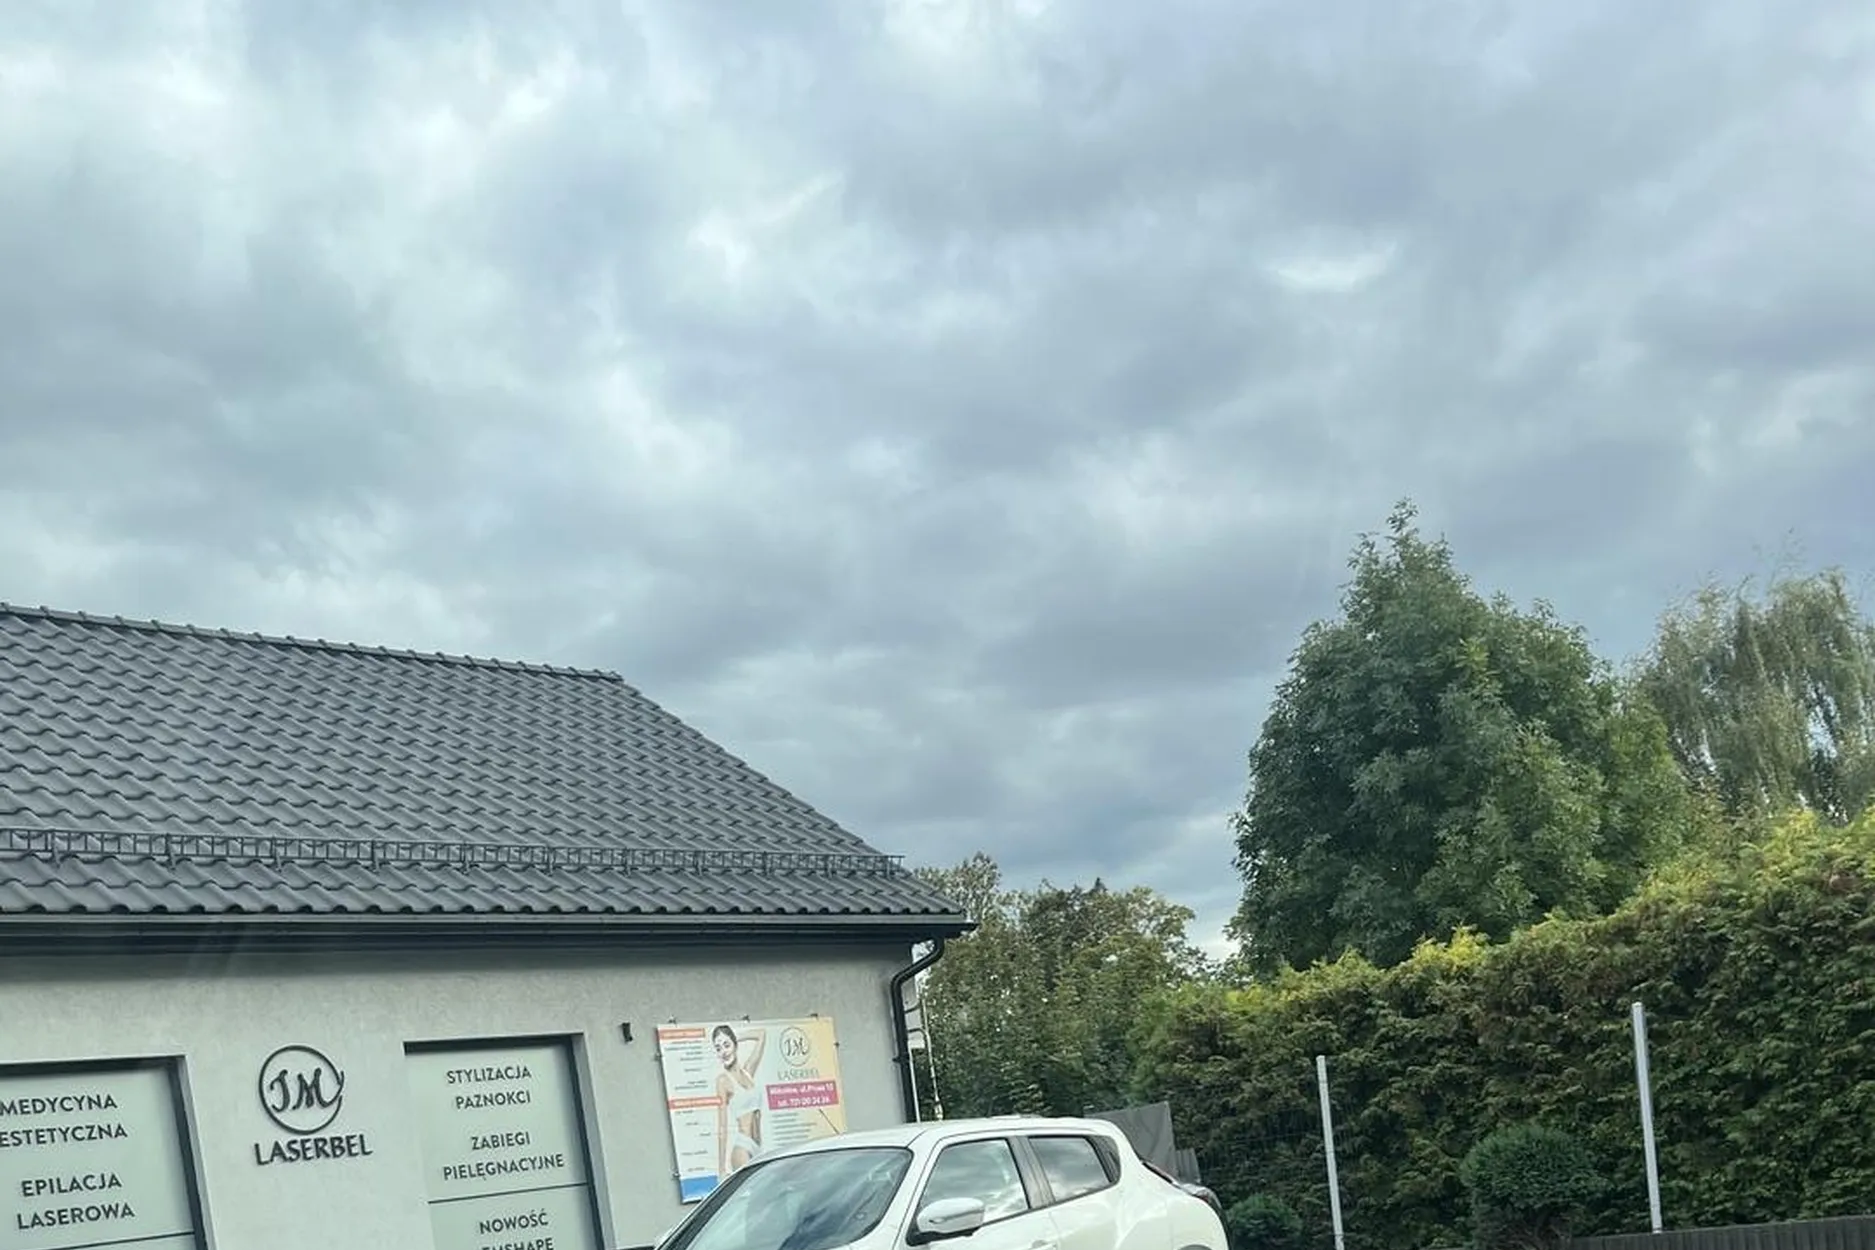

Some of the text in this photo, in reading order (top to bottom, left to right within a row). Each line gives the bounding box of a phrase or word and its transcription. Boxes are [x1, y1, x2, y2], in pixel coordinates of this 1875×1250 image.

[446, 1066, 532, 1085] STYLIZACJA
[0, 1094, 118, 1117] MEDYCYNA
[455, 1090, 531, 1110] PAZNOKCI
[0, 1123, 128, 1147] ESTETYCZNA
[471, 1131, 531, 1151] ZABIEGI
[254, 1133, 374, 1166] LASERBEL
[443, 1153, 565, 1181] PIELĘGNACYJNE
[21, 1173, 122, 1198] EPILACJA
[17, 1202, 135, 1231] LASEROWA
[479, 1207, 549, 1234] NOWOŚĆ
